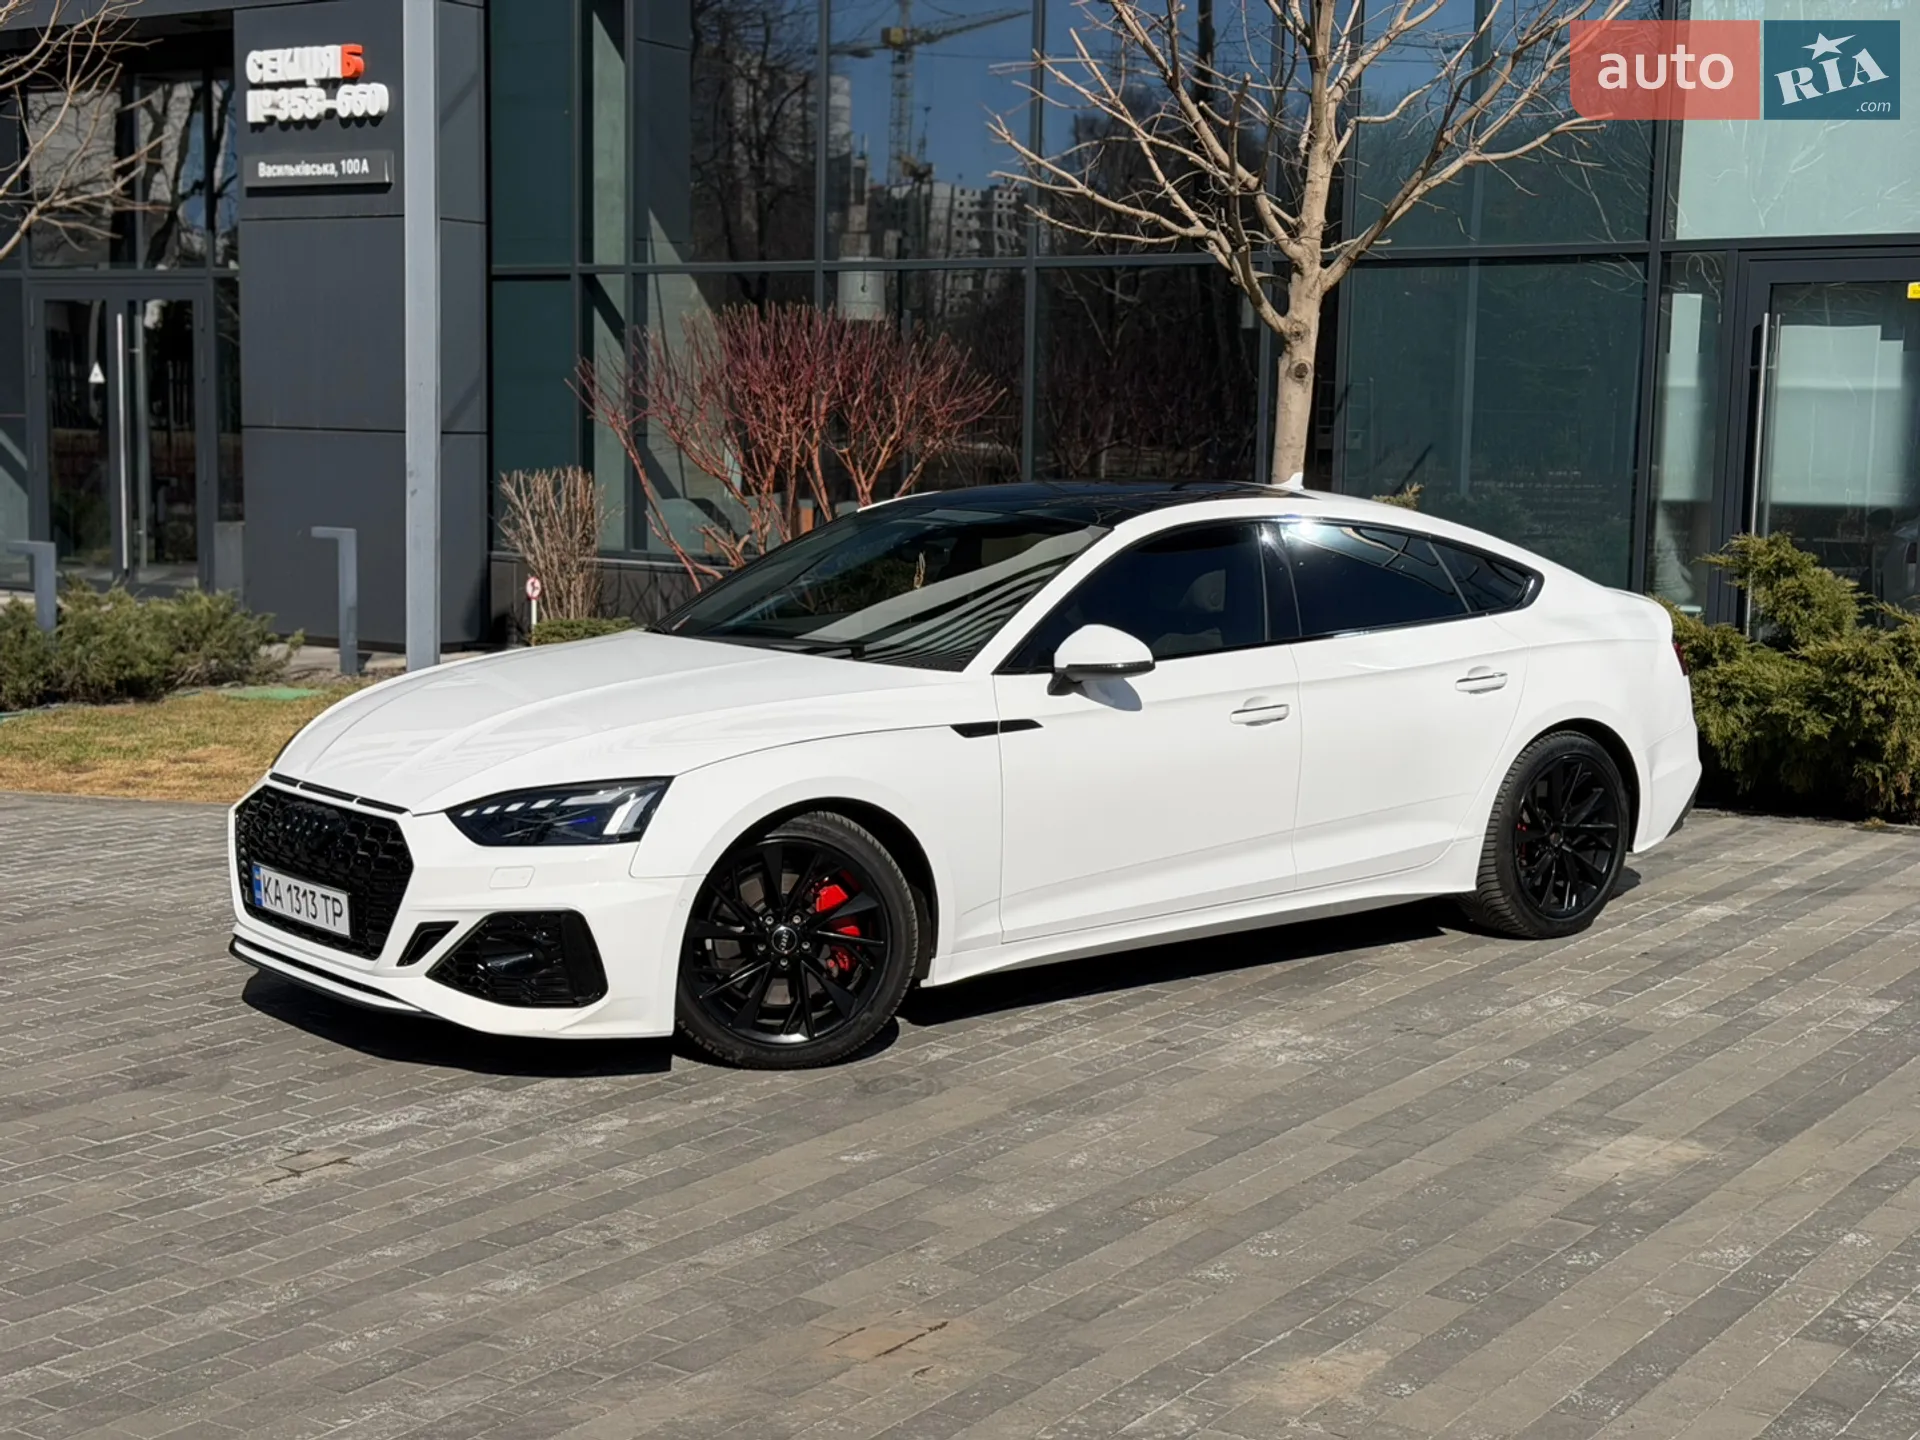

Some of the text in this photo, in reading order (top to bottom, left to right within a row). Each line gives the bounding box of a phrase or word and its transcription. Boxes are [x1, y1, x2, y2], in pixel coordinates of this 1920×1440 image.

[263, 874, 344, 927] KA 1313 TP
